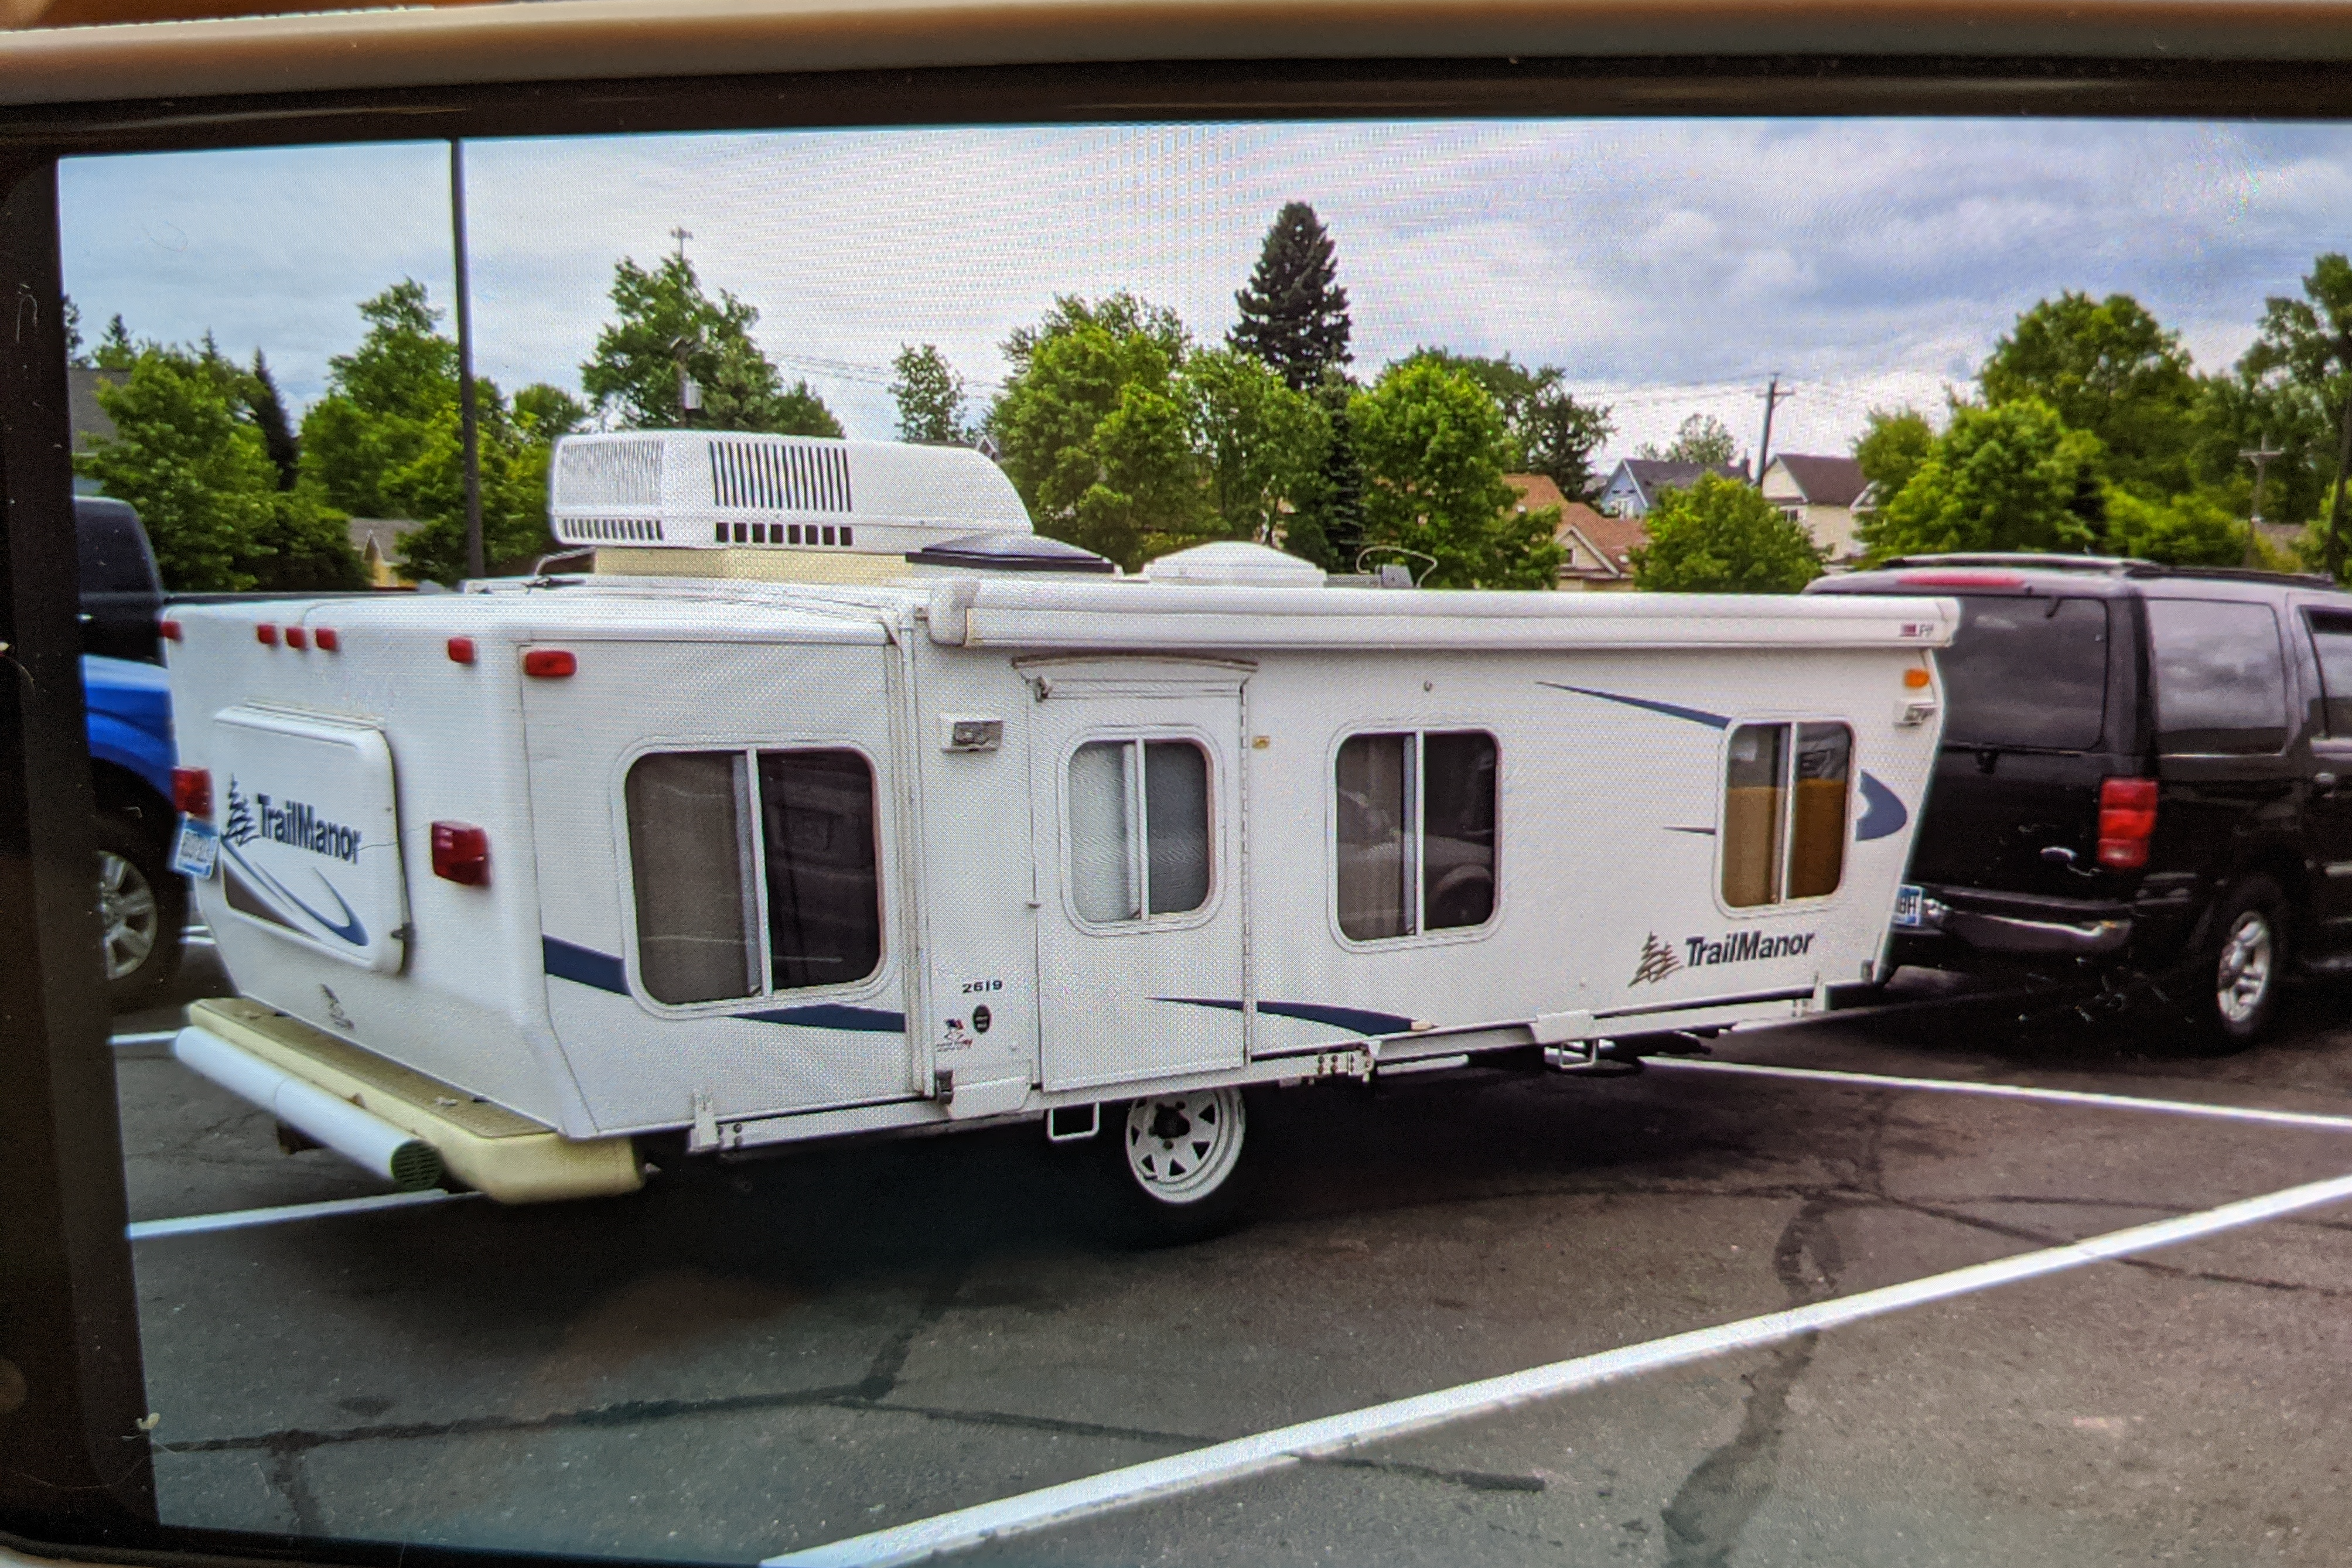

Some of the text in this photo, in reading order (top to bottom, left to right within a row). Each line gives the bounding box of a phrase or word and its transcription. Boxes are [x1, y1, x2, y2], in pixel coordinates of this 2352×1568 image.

[257, 793, 361, 864] TrailManor
[1685, 930, 1815, 967] TrailManor
[962, 980, 1003, 993] 2619
